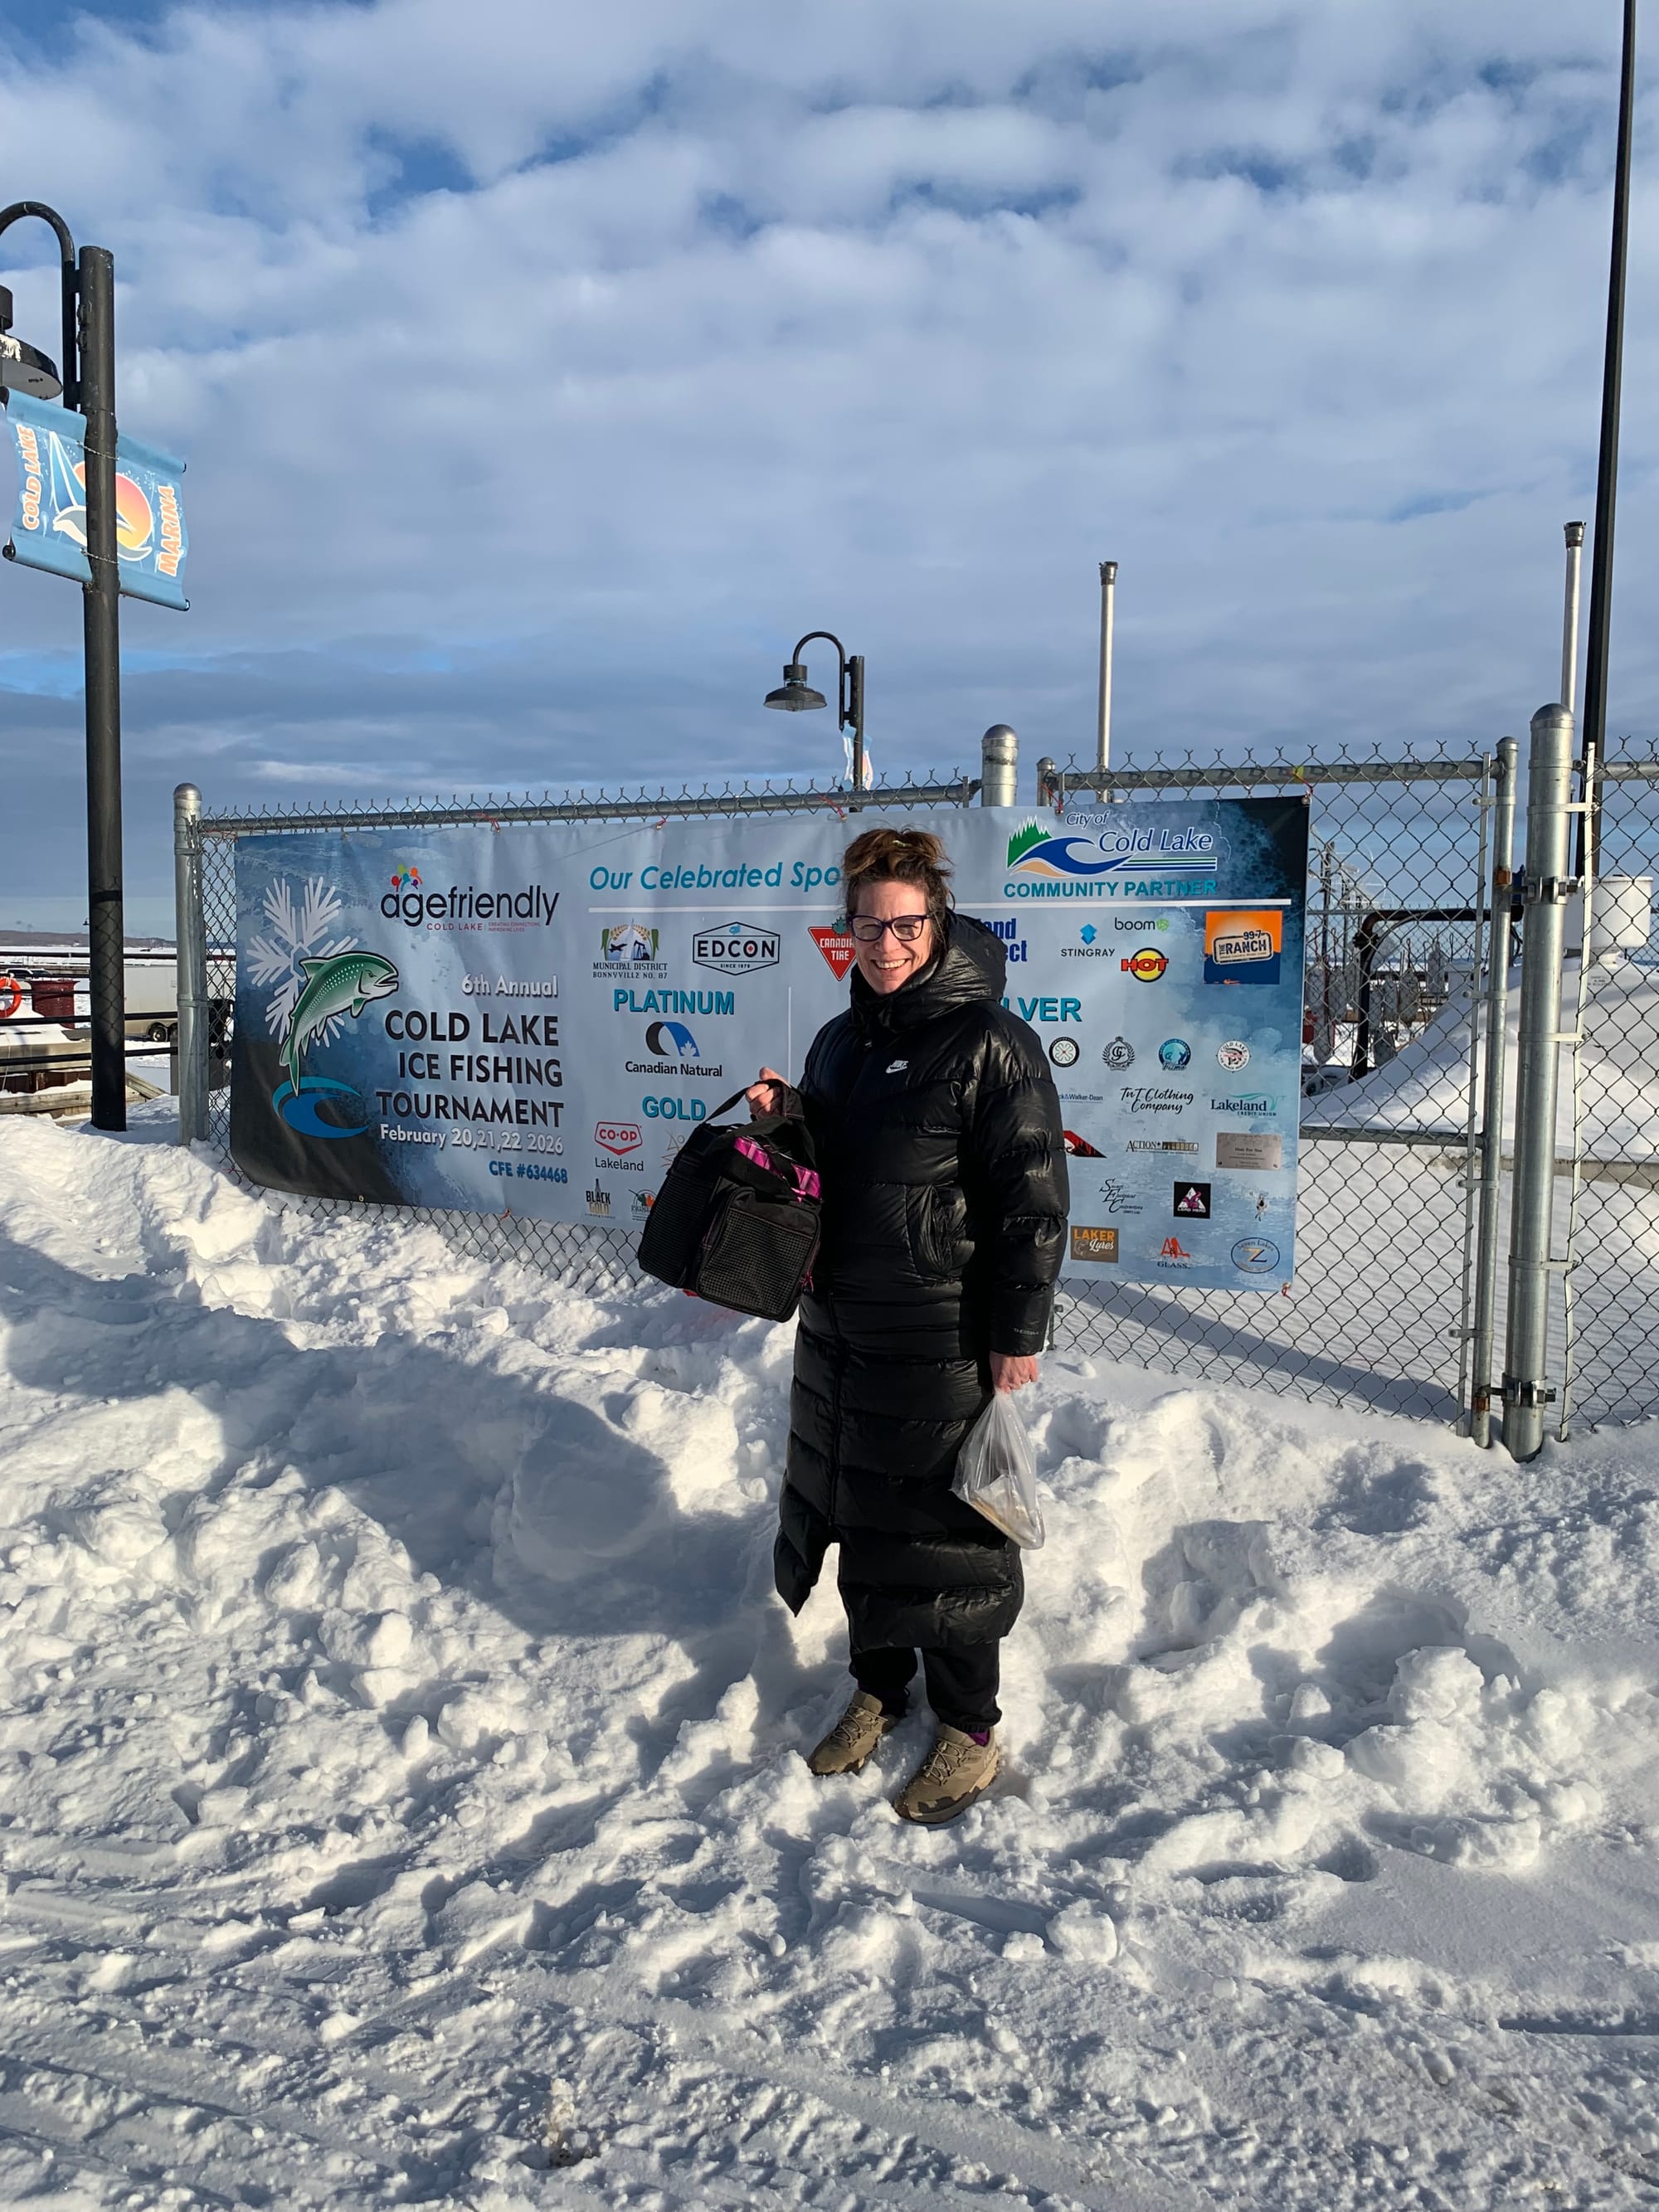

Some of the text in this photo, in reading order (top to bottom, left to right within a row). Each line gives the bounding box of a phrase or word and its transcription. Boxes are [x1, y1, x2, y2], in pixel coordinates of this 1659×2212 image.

[17, 424, 41, 530] COLD LAKE
[158, 485, 182, 576] MARINA
[1066, 810, 1110, 828] City of
[1099, 826, 1213, 852] Cold Lake
[590, 866, 633, 890] Our
[640, 862, 783, 890] Celebrated
[1004, 879, 1217, 897] COMMUNITY PARTNER
[381, 885, 560, 926] agefriendly
[426, 922, 483, 931] COLD LAKE
[1115, 916, 1155, 931] boom
[698, 940, 775, 958] EDCON
[820, 938, 854, 948] CANADIA
[1225, 940, 1267, 955] RANCH
[831, 950, 849, 960] TIRE
[1061, 948, 1115, 957] STINGRAY
[592, 962, 668, 971] MUNICIPAL DISTRICT
[1121, 958, 1169, 972] HOT
[462, 972, 558, 997] 6th Annual
[613, 989, 735, 1014] PLATINUM
[385, 1009, 559, 1047] COLD LAKE
[399, 1052, 563, 1087] ICE FISHING
[625, 1061, 722, 1077] Canadian Natural
[1146, 1088, 1194, 1105] Clothing
[376, 1091, 564, 1128] TOURNAMENT
[642, 1096, 707, 1121] GOLD
[1131, 1100, 1183, 1115] Company
[1211, 1099, 1267, 1112] Lakeland
[380, 1124, 564, 1155] February 20,21,22 2026
[489, 1160, 568, 1184] CFE #634468
[595, 1157, 645, 1171] Lakeland
[586, 1191, 611, 1204] BLACK
[589, 1202, 610, 1214] GOLD
[1073, 1228, 1116, 1242] LAKER
[1089, 1238, 1114, 1252] Lures
